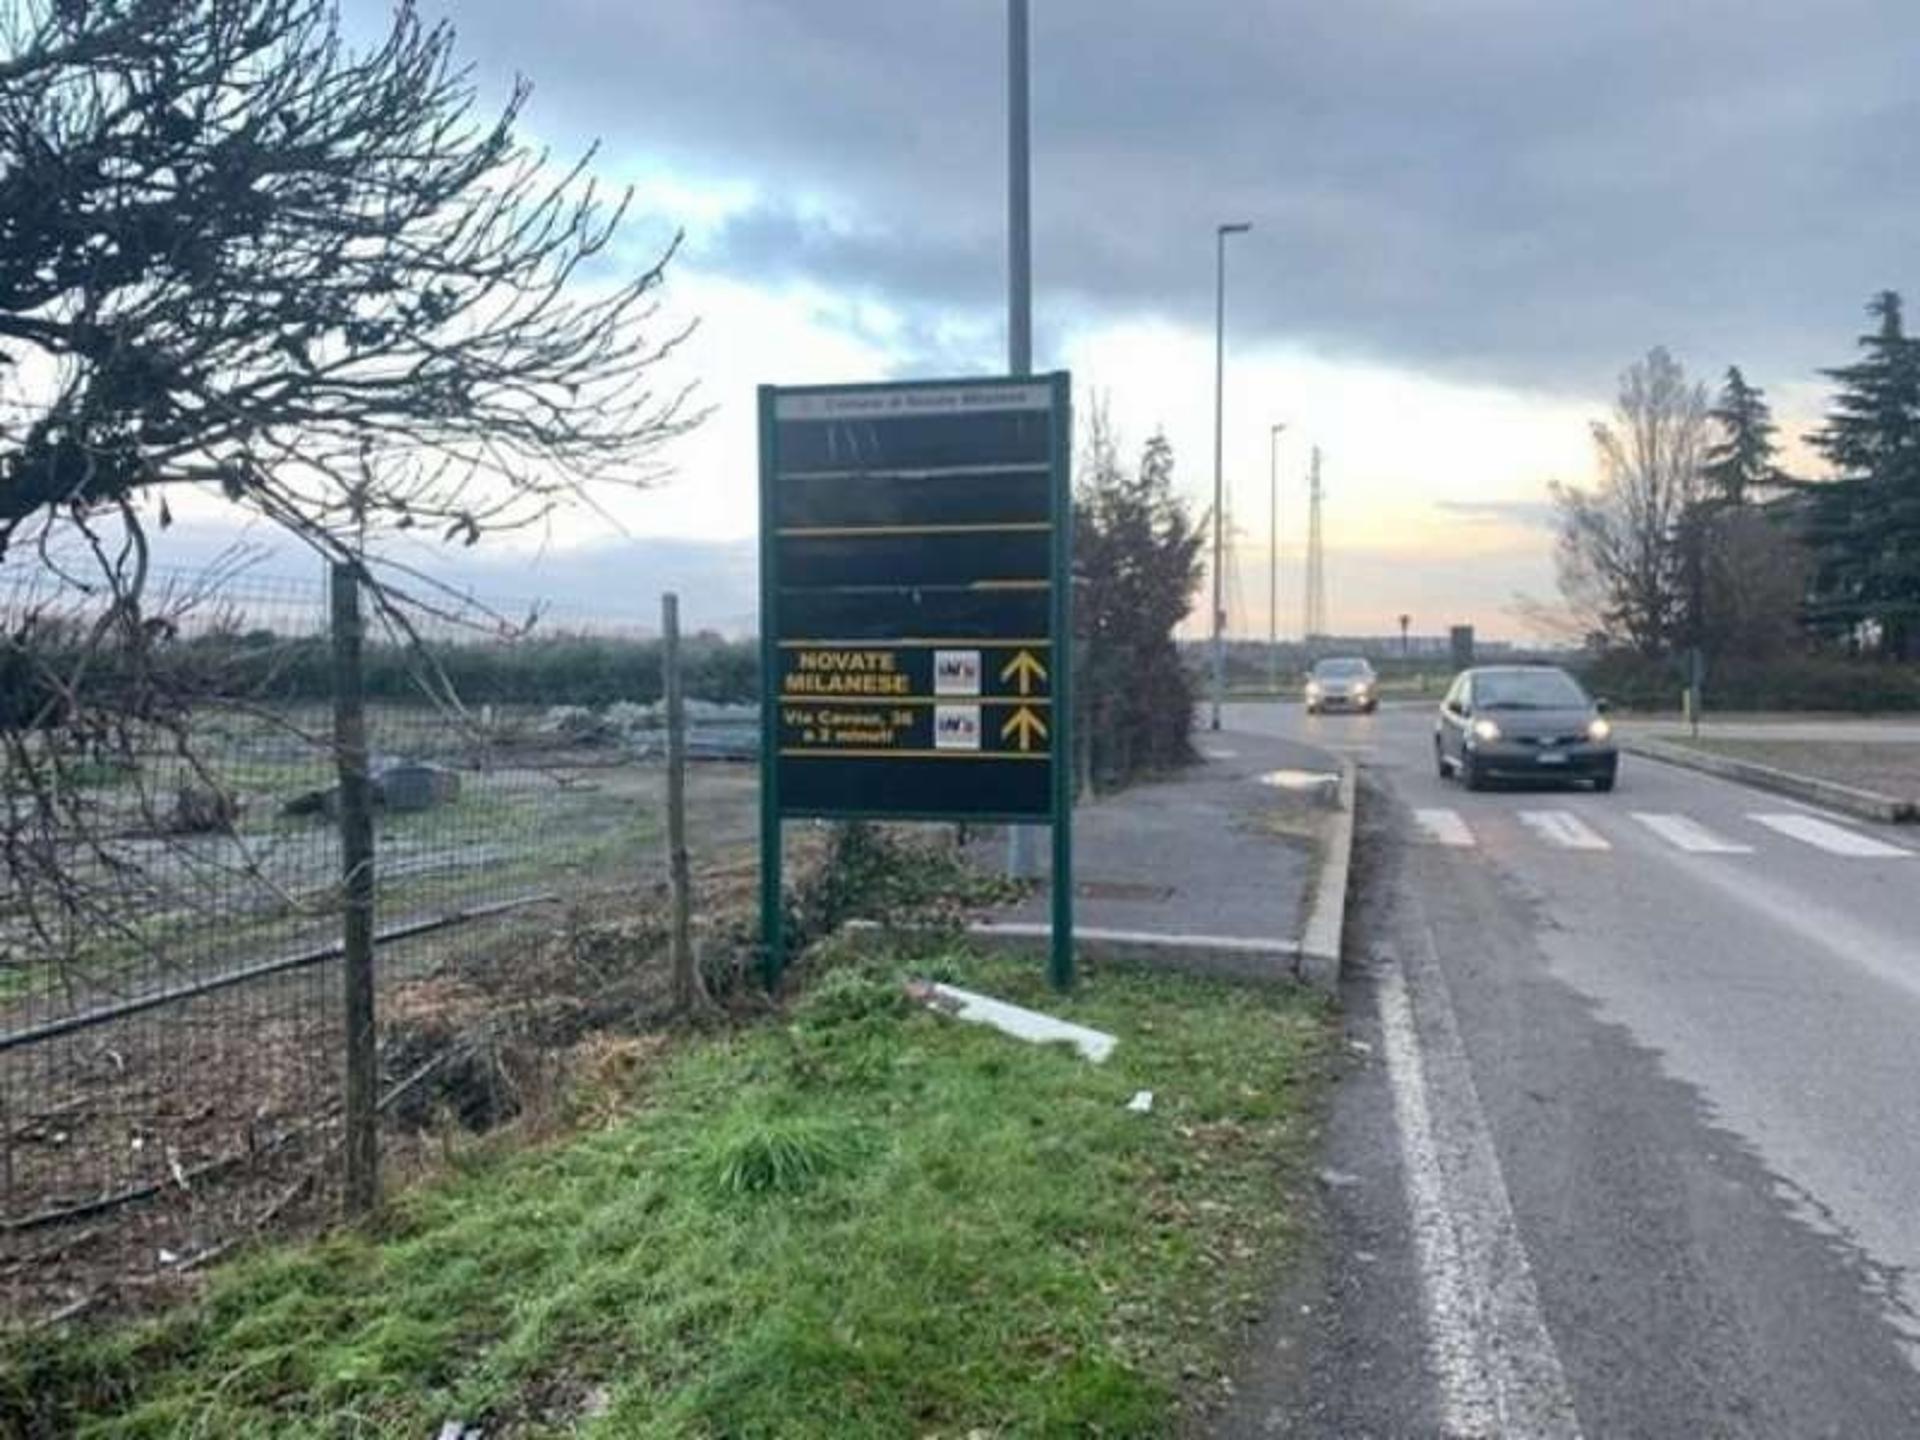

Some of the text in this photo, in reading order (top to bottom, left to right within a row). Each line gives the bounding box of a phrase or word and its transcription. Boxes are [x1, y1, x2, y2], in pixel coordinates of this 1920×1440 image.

[800, 651, 896, 671] NOVATE
[785, 673, 911, 693] MILANESE
[784, 710, 814, 725] Via
